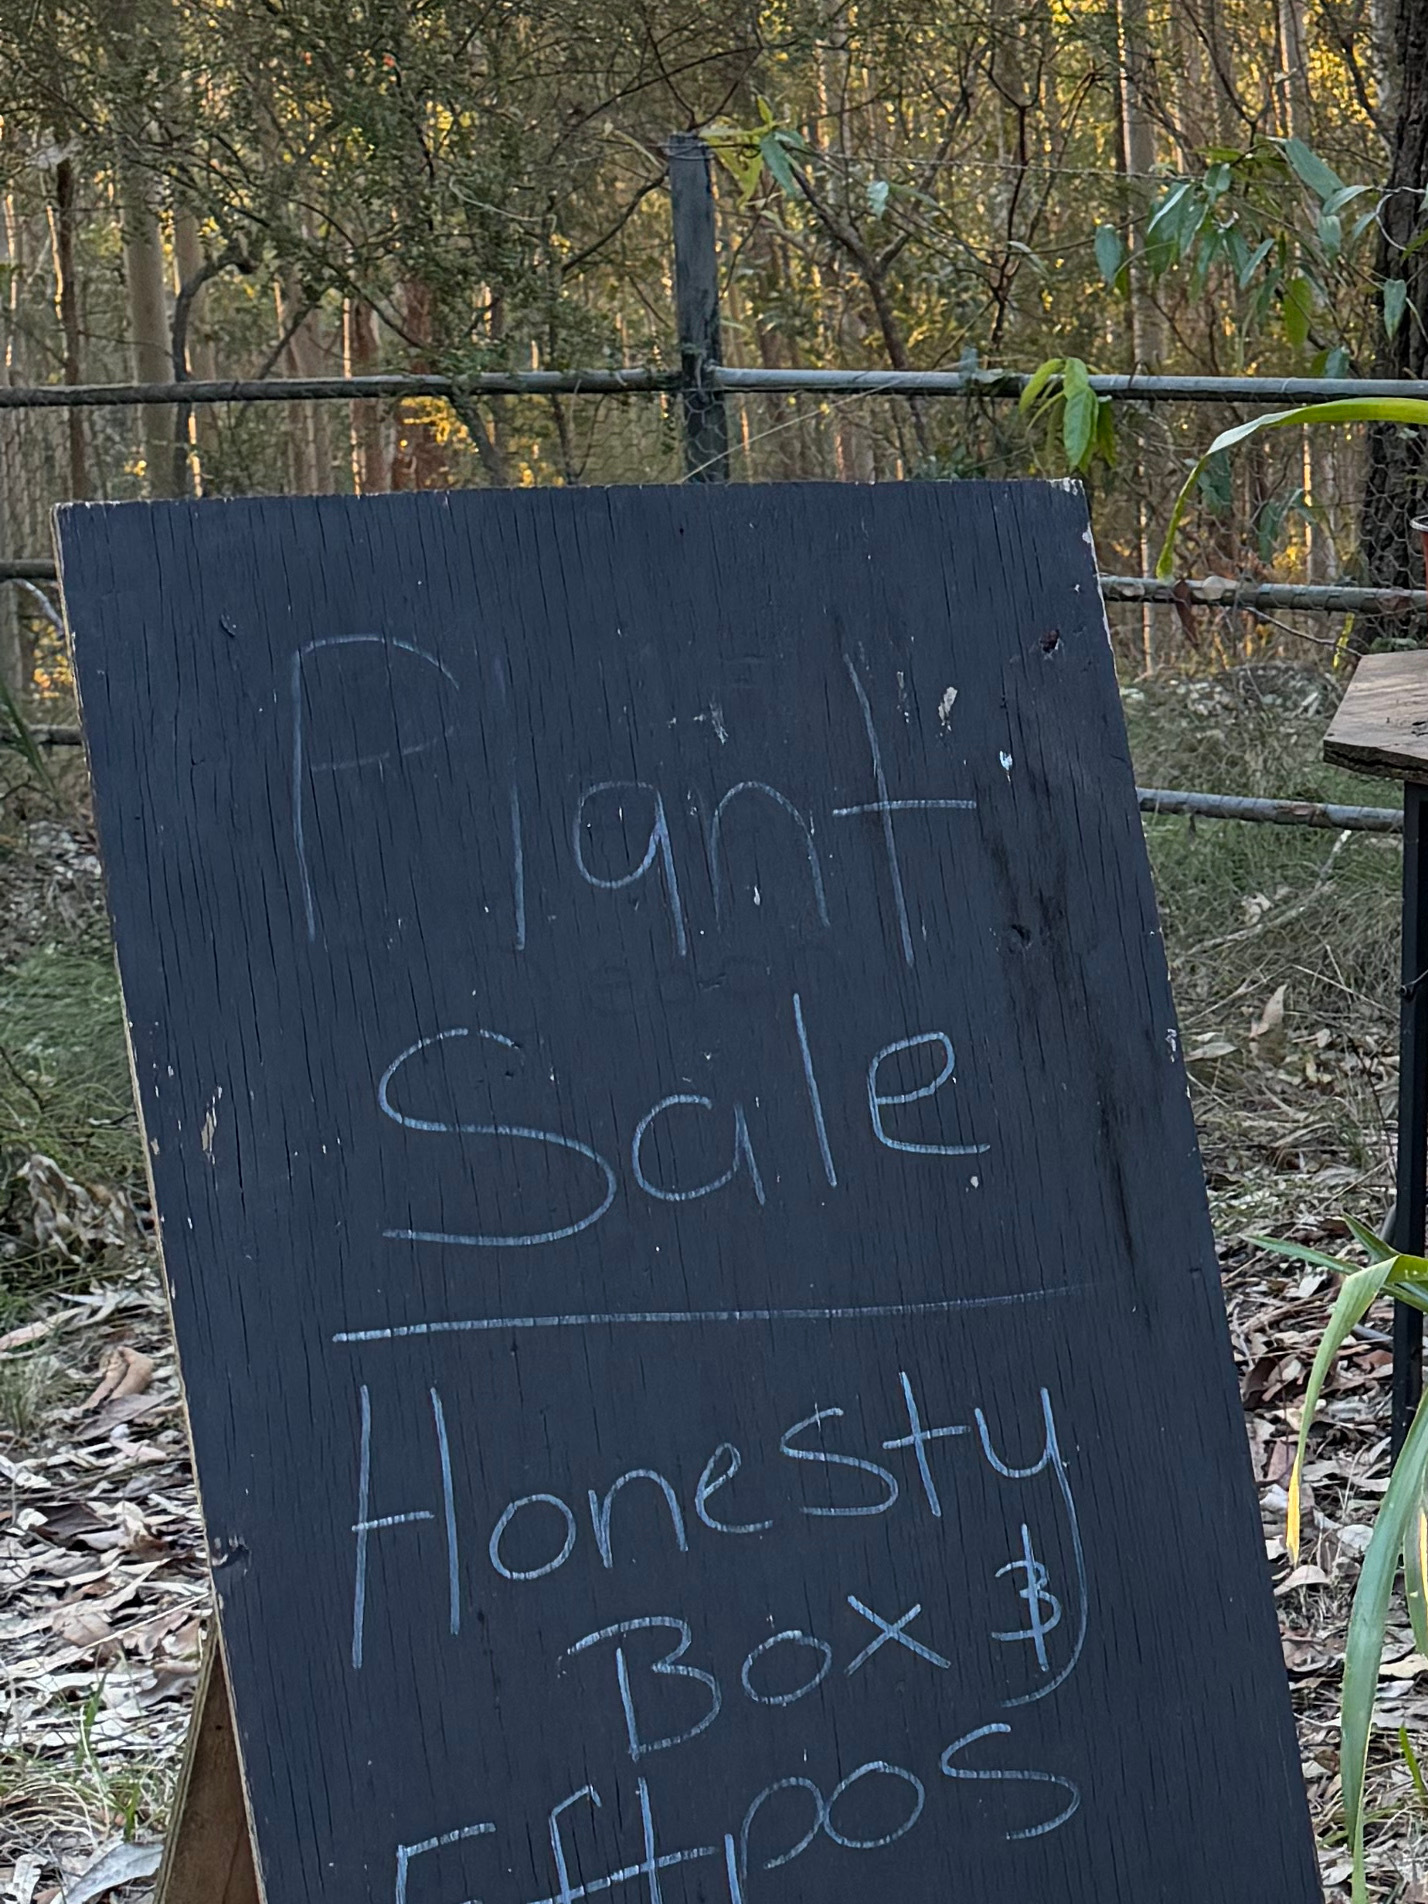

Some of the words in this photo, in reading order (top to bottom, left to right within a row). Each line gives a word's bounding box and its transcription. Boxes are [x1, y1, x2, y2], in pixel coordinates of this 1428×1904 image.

[291, 621, 977, 966] Plant
[378, 992, 990, 1246] Sale
[352, 1371, 1089, 1708] Honesty
[558, 1594, 952, 1761] Box
